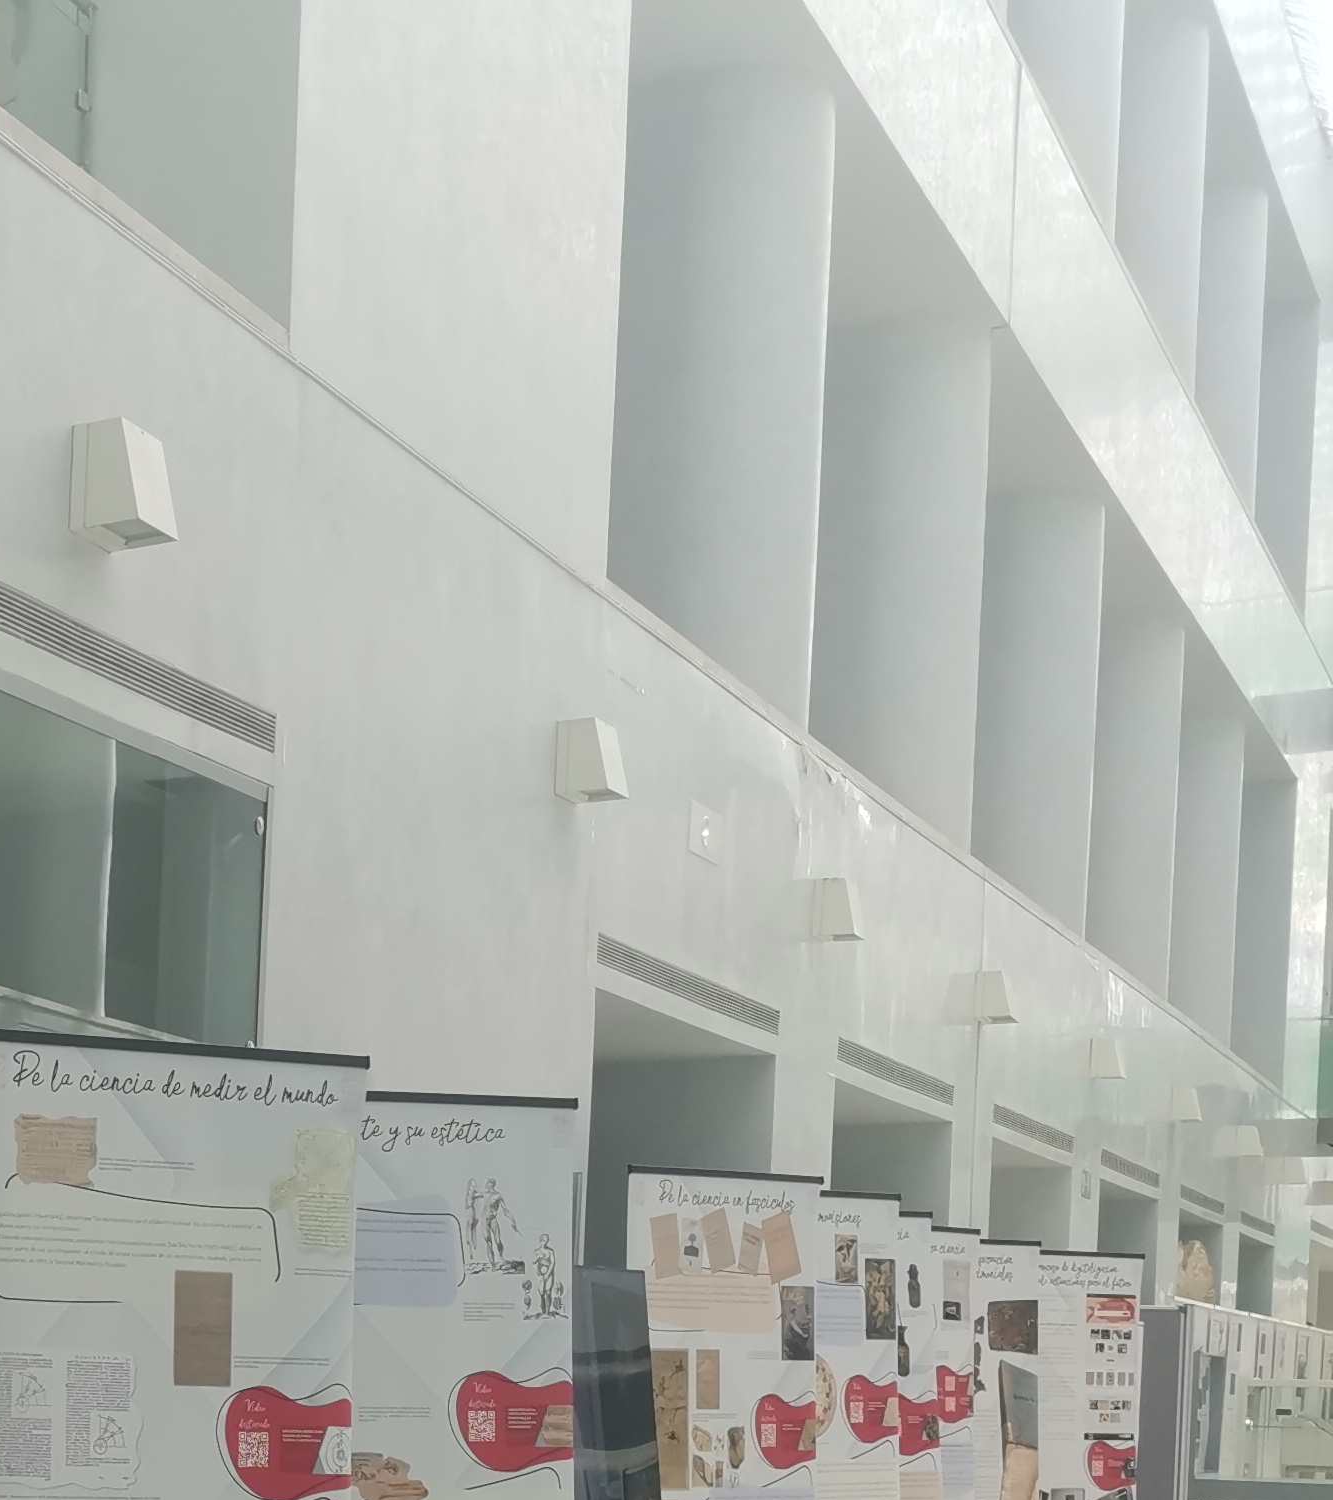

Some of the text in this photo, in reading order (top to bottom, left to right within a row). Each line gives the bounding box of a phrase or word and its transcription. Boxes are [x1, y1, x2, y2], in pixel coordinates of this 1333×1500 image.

[12, 1050, 339, 1107] De la ciencia de medir el mundo
[361, 1115, 383, 1140] te
[382, 1126, 402, 1152] y
[405, 1126, 426, 1145] su
